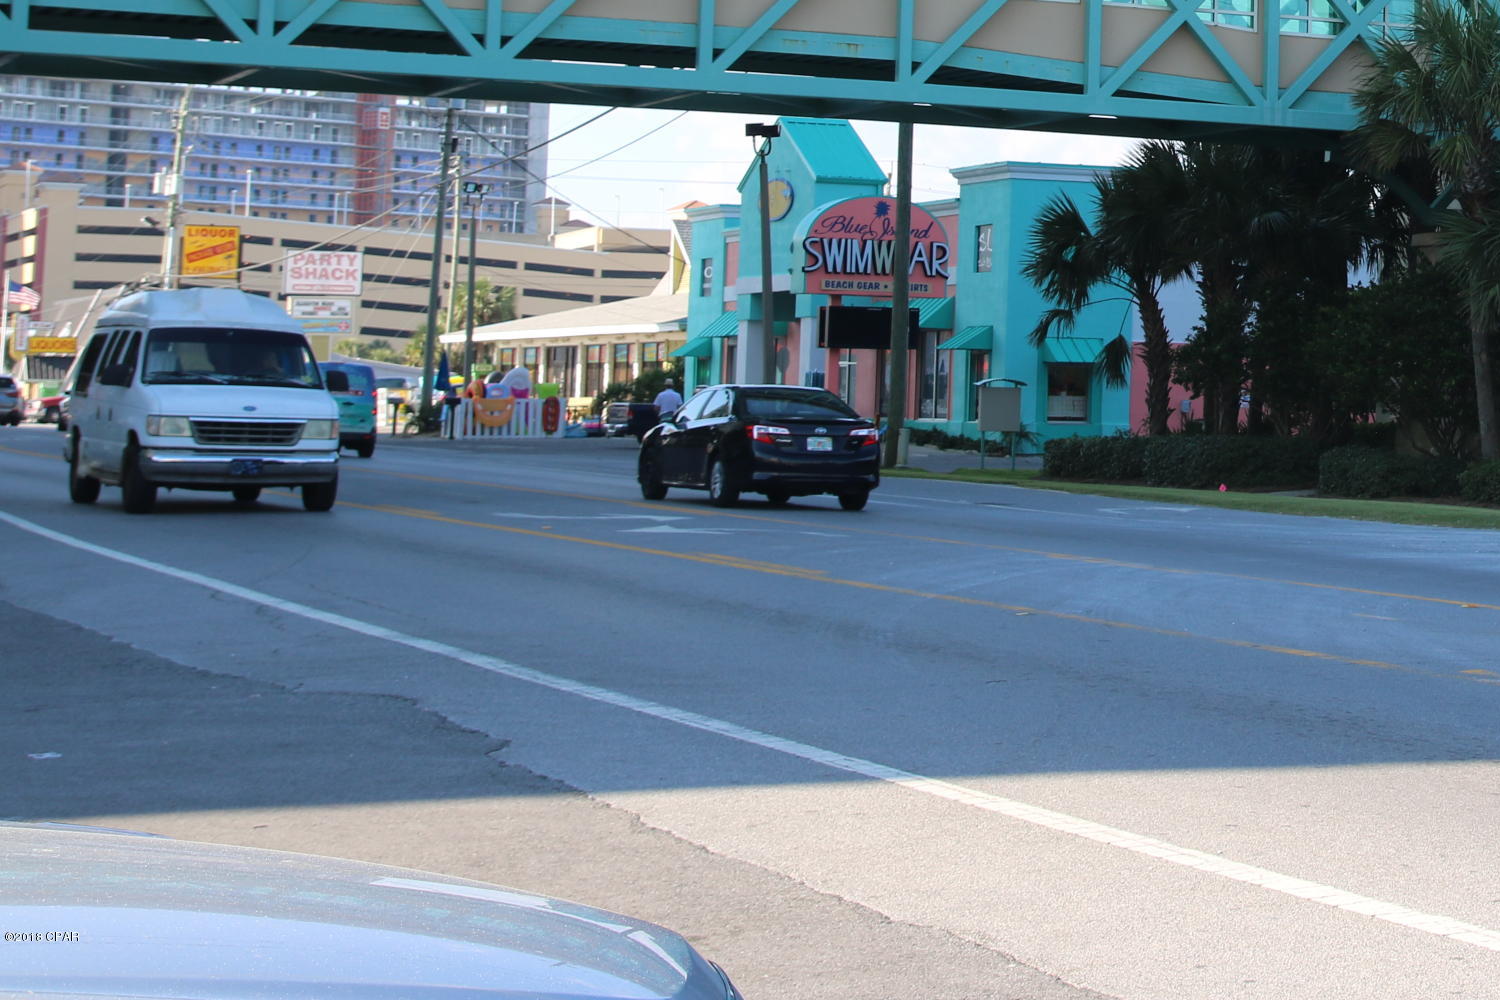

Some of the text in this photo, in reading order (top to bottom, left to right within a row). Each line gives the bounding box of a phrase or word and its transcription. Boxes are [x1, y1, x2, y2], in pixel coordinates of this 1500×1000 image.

[187, 228, 237, 238] LIQUOR
[814, 215, 934, 239] Blue Isnd
[293, 253, 358, 267] PARTY
[802, 236, 950, 280] SWIMWAR
[290, 266, 359, 281] SHACK
[825, 280, 854, 290] BEACH
[857, 281, 881, 291] GEAR
